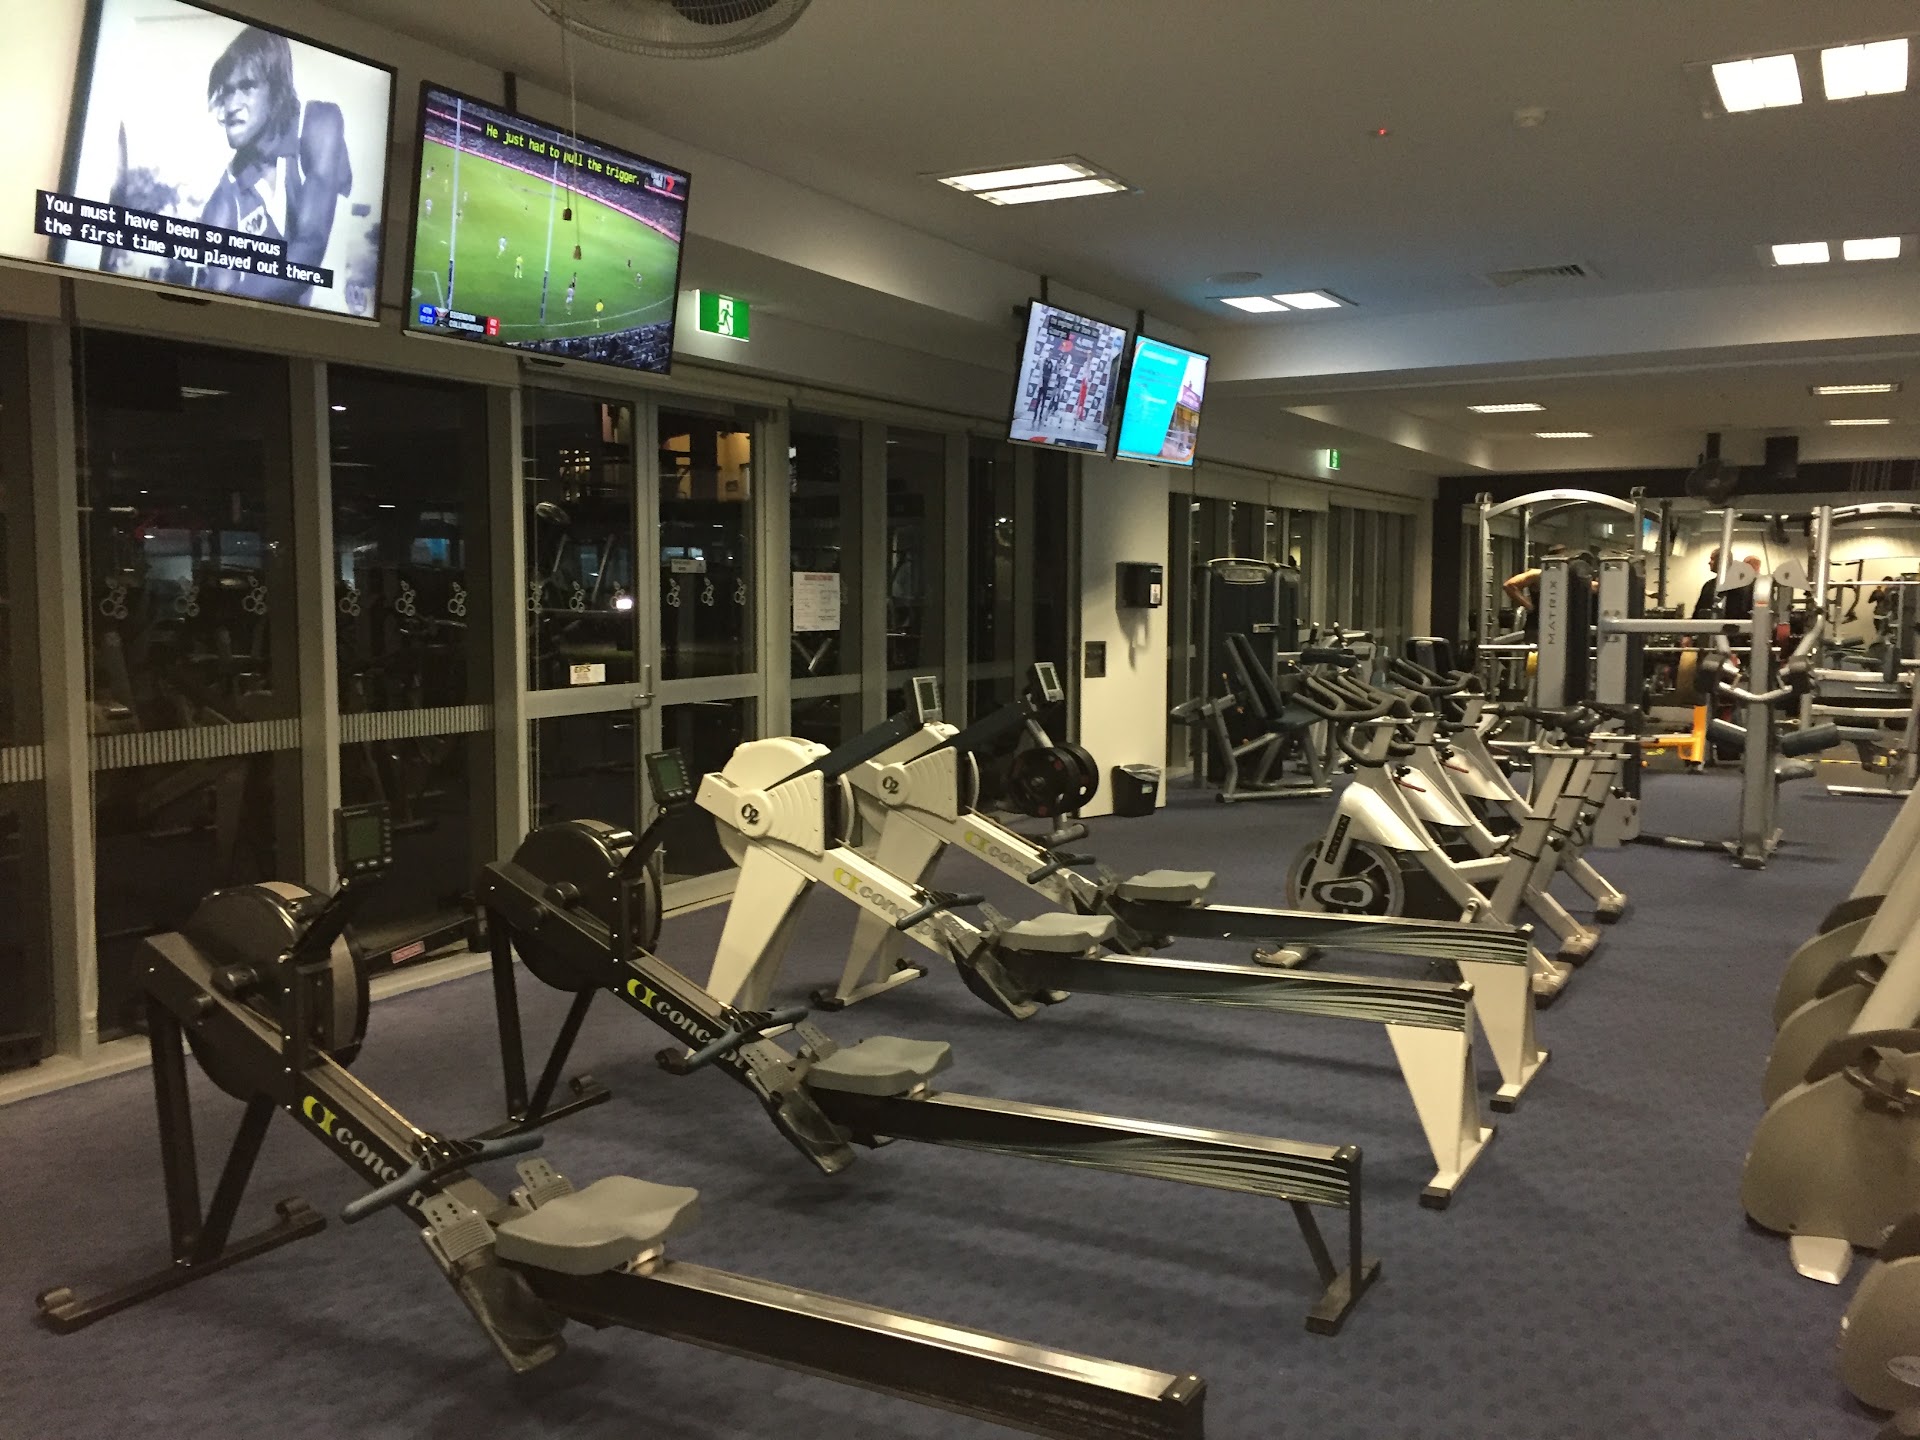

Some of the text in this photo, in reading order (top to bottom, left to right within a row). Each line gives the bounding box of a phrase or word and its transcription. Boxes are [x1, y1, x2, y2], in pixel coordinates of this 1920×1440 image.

[486, 123, 499, 138] He
[503, 130, 524, 147] just
[529, 138, 545, 154] had
[549, 144, 560, 159] to
[563, 151, 583, 167] pull
[587, 158, 602, 173] the
[606, 163, 640, 185] trigger.
[44, 216, 324, 284] the first time you played out there.
[45, 194, 281, 256] You must have been so nervous
[1548, 580, 1558, 645] MATRIX
